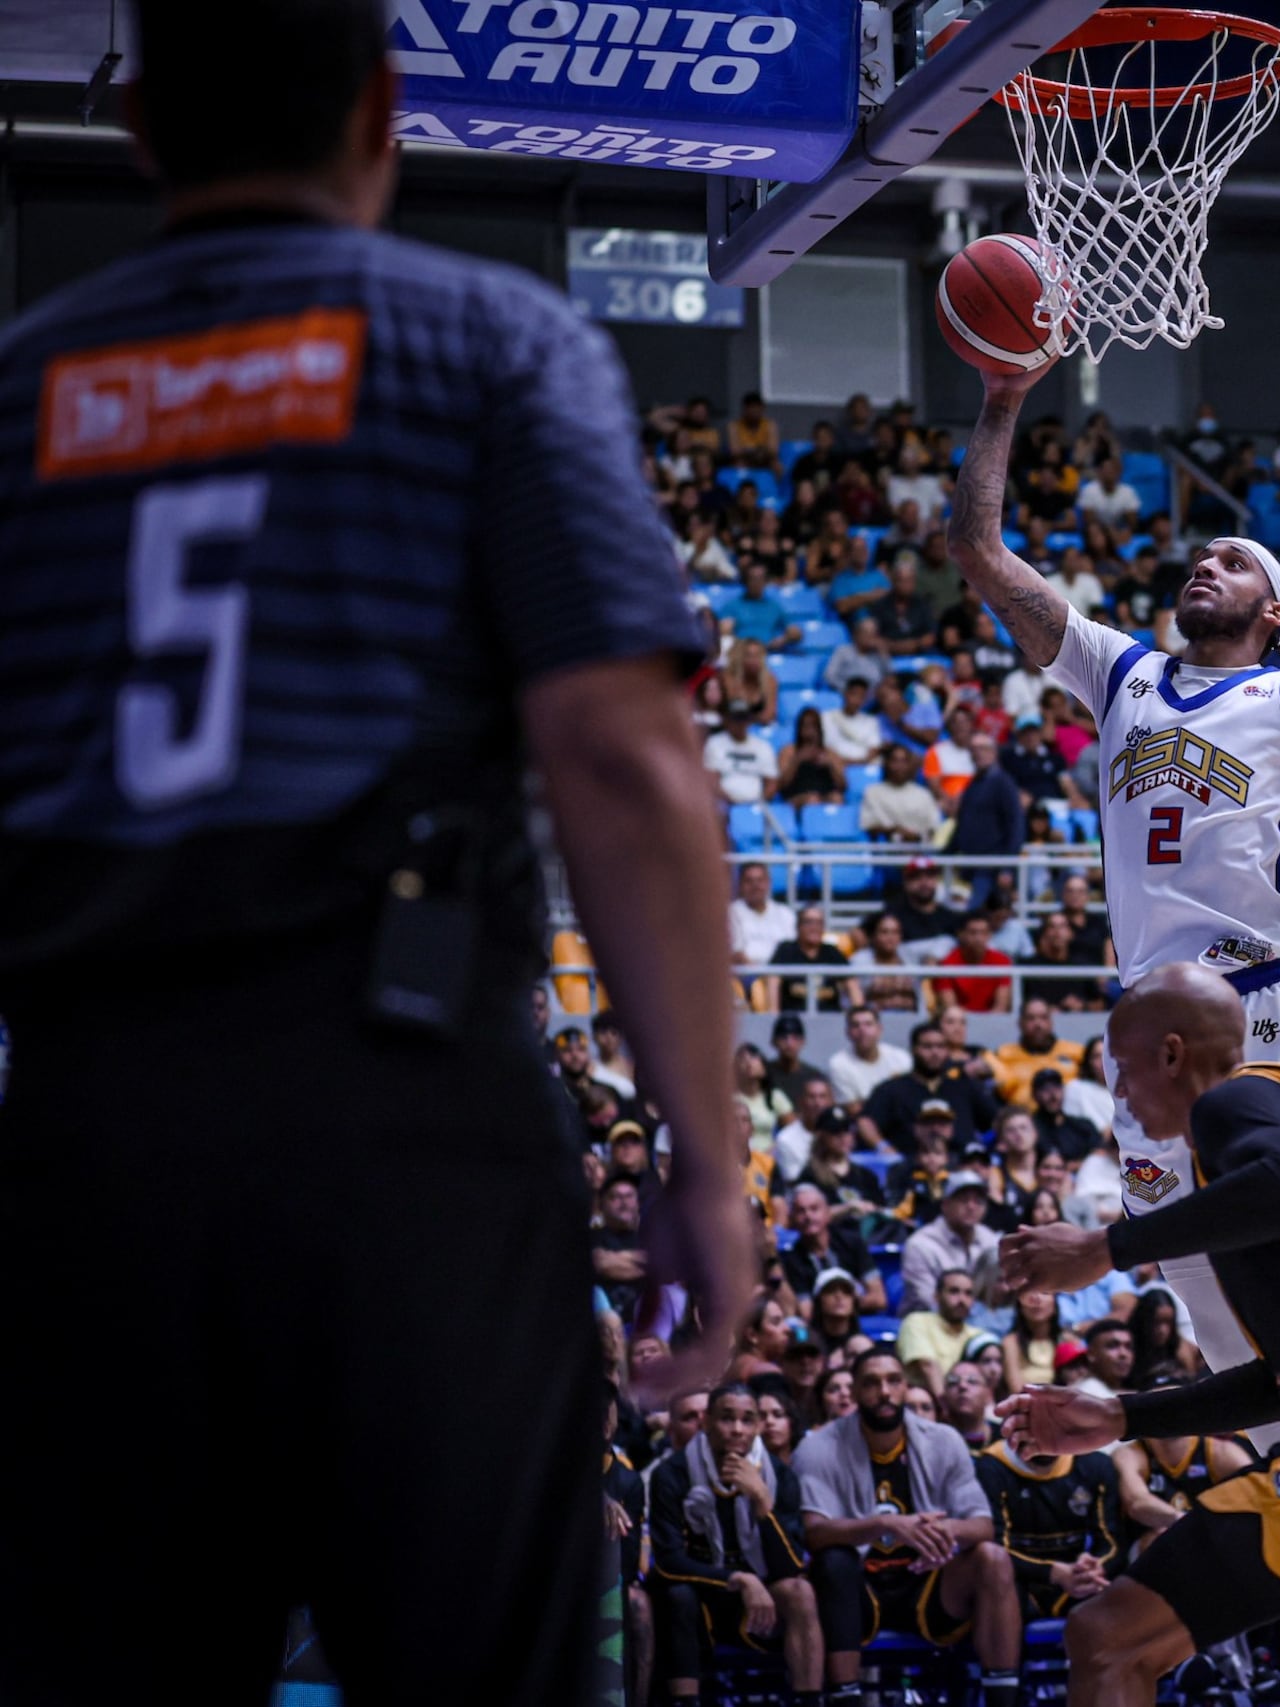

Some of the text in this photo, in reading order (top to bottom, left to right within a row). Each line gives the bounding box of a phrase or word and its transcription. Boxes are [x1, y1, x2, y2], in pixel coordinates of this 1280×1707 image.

[487, 42, 760, 95] AUTO
[466, 119, 776, 161] TOÑITO
[487, 140, 732, 169] AUTO
[606, 276, 707, 323] 306
[113, 474, 270, 805] 5
[1108, 726, 1255, 808] OSOS
[1130, 767, 1203, 799] MANATI
[1147, 806, 1184, 866] 2
